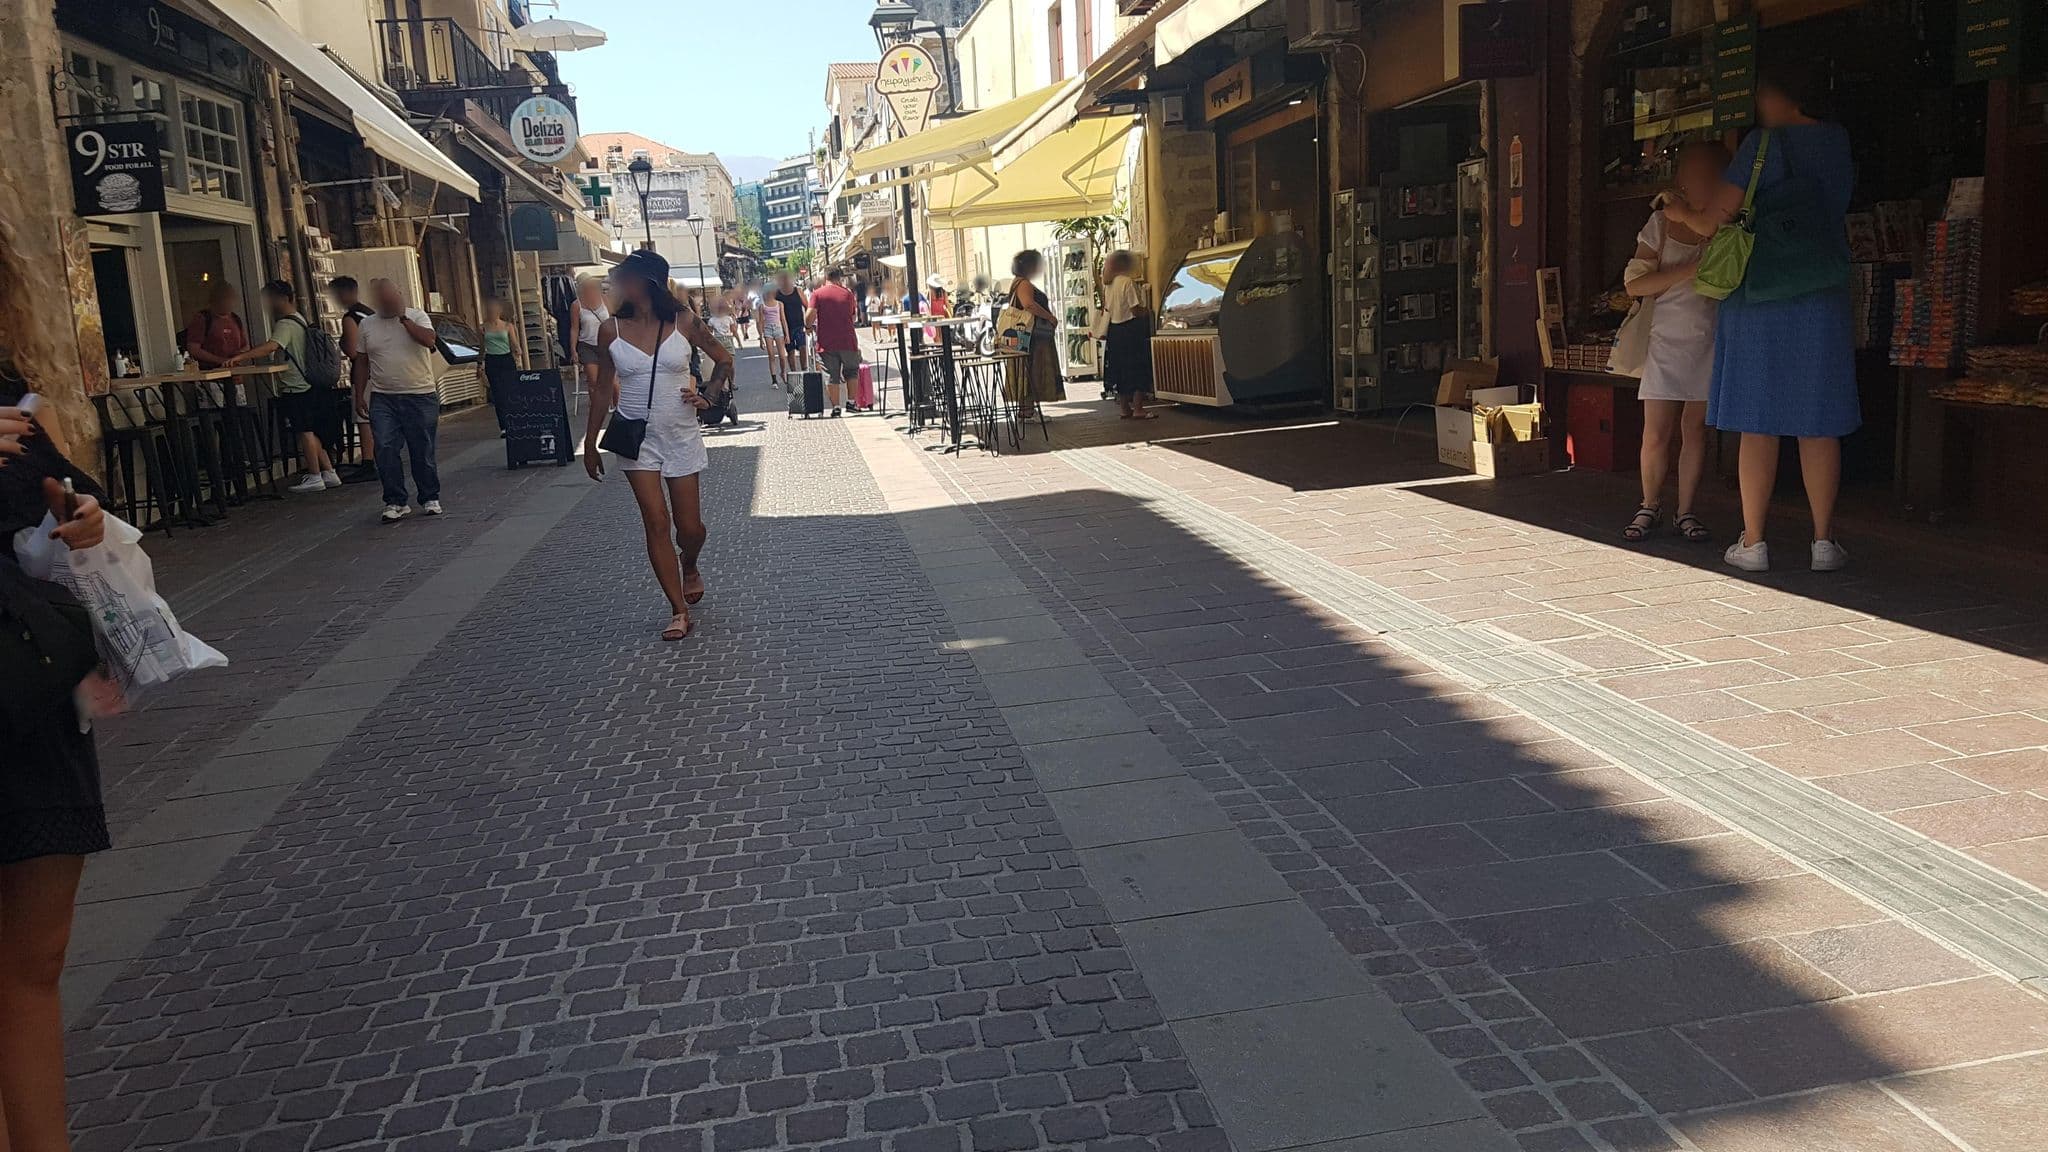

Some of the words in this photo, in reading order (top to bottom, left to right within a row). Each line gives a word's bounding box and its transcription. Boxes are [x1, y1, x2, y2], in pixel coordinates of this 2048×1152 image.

[148, 7, 160, 47] 9
[74, 130, 106, 176] 9
[107, 142, 146, 159] STR
[104, 163, 124, 171] FOOD
[125, 162, 140, 170] FOR
